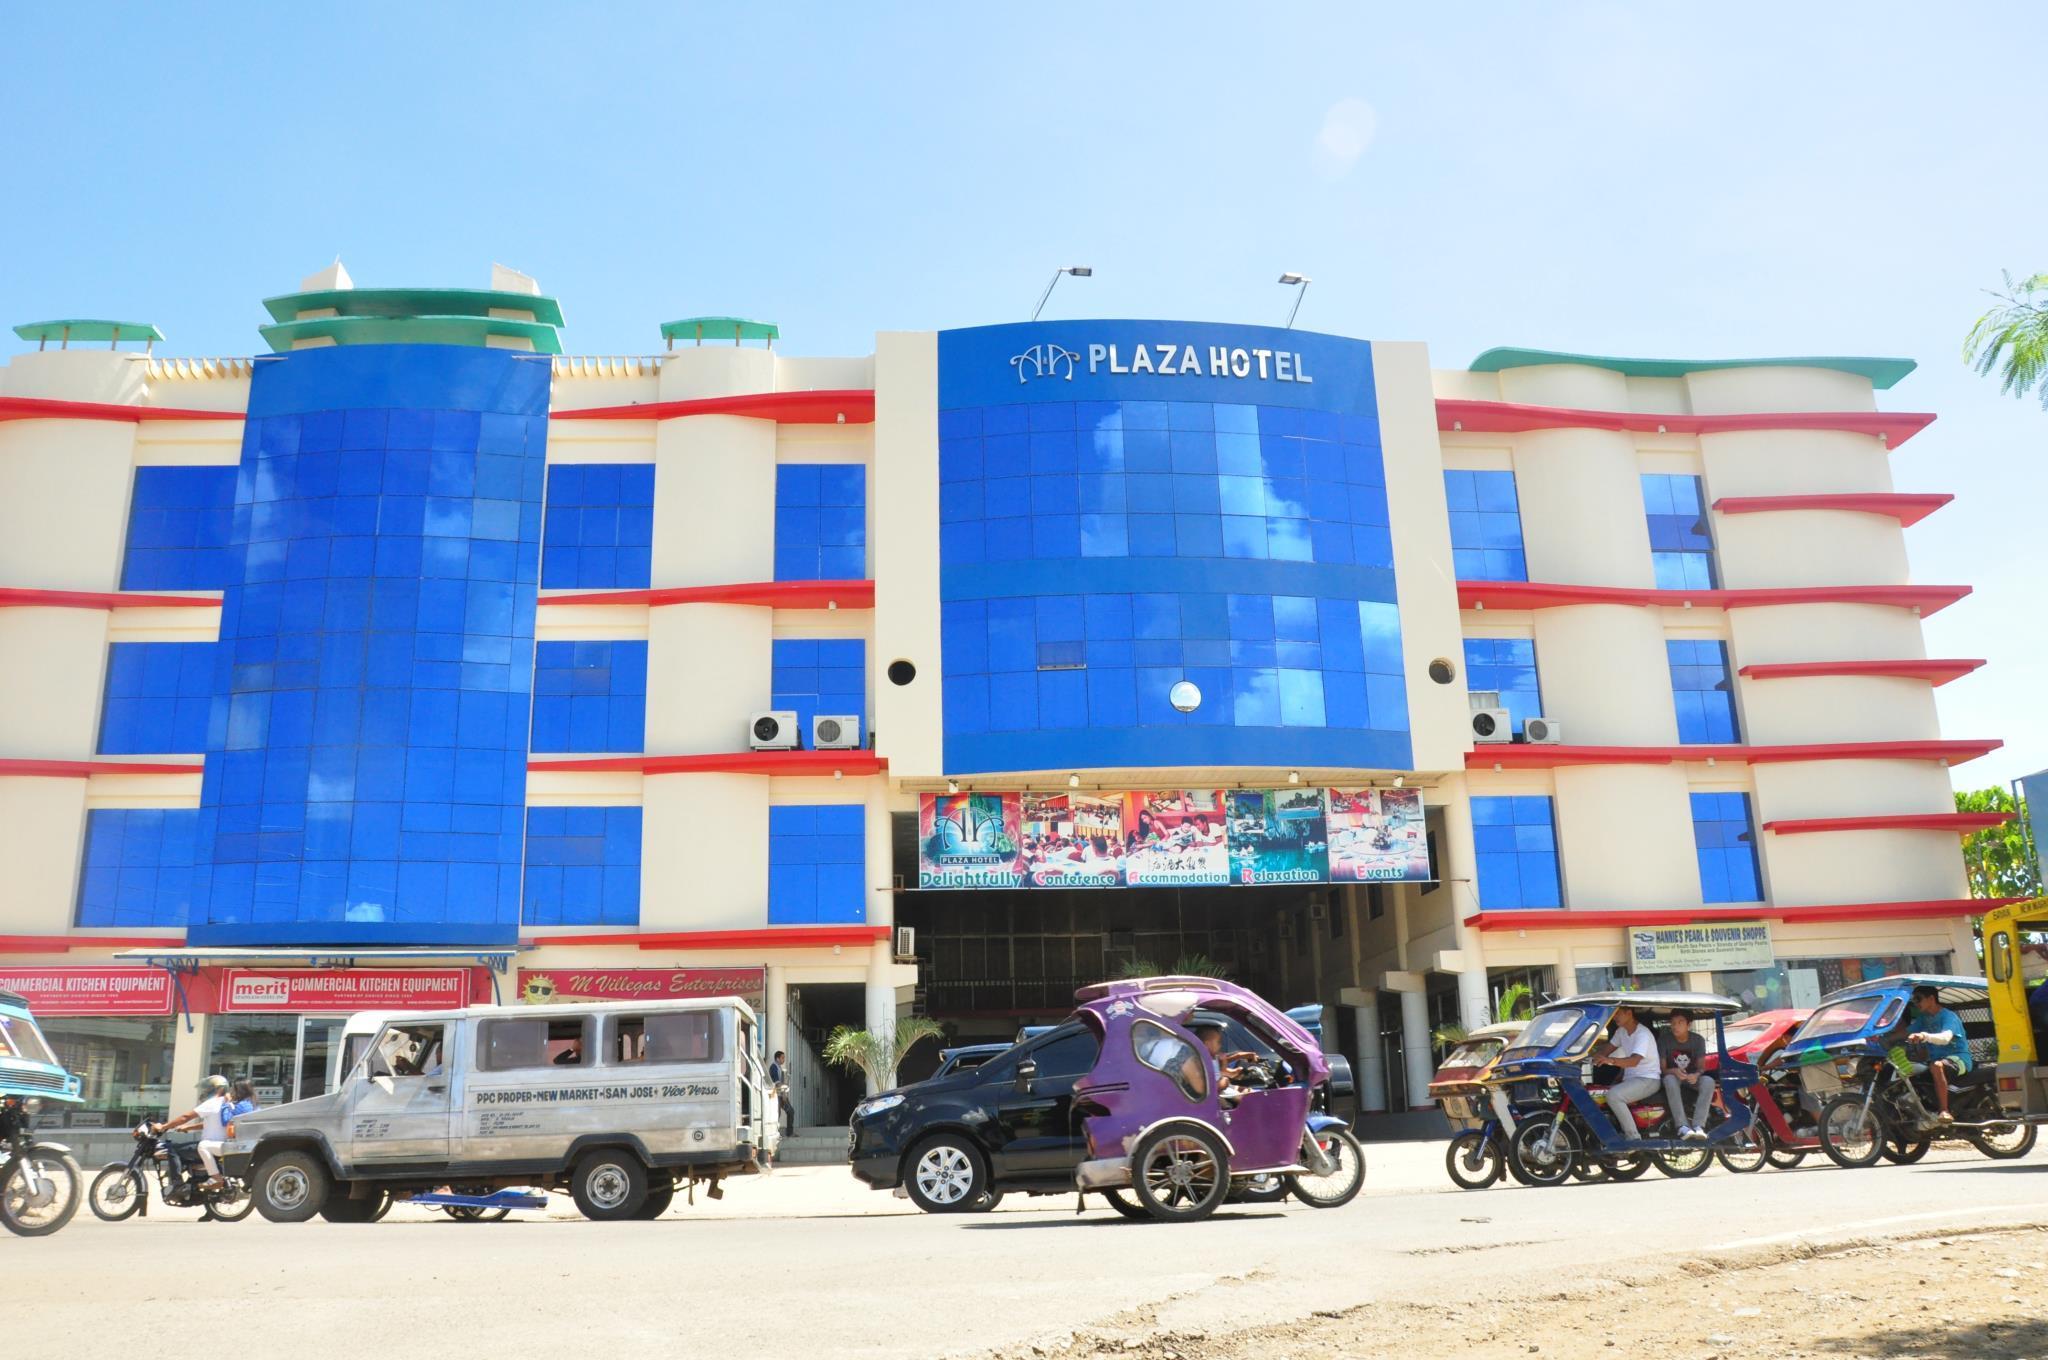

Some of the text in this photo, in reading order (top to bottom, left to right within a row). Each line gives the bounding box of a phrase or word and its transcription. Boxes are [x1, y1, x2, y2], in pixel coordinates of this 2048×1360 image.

[1089, 344, 1202, 376] PLAZA
[1209, 346, 1313, 384] HOTEL
[1035, 872, 1115, 886] Conference
[1128, 872, 1228, 883] Accommodation
[1242, 869, 1320, 883] Relaxation
[1357, 865, 1403, 879] Events
[920, 872, 1021, 888] Delightfully
[1656, 930, 1683, 944] HANNIE'S
[1684, 929, 1704, 943] PEARL
[1711, 927, 1741, 941] SOUVENIR
[1742, 926, 1766, 941] SHOPPE
[66, 978, 107, 992] KITCHEN
[109, 977, 166, 992] EQUIPMENT
[235, 981, 287, 995] merit
[291, 977, 458, 993] COMMERCIAL KITCHEN EQUIPMENT
[569, 973, 762, 996] M Villegas Enterprises
[477, 1092, 495, 1104] PPC
[630, 1086, 653, 1098] JOSE
[662, 1085, 686, 1097] Vice
[687, 1084, 720, 1096] Versa
